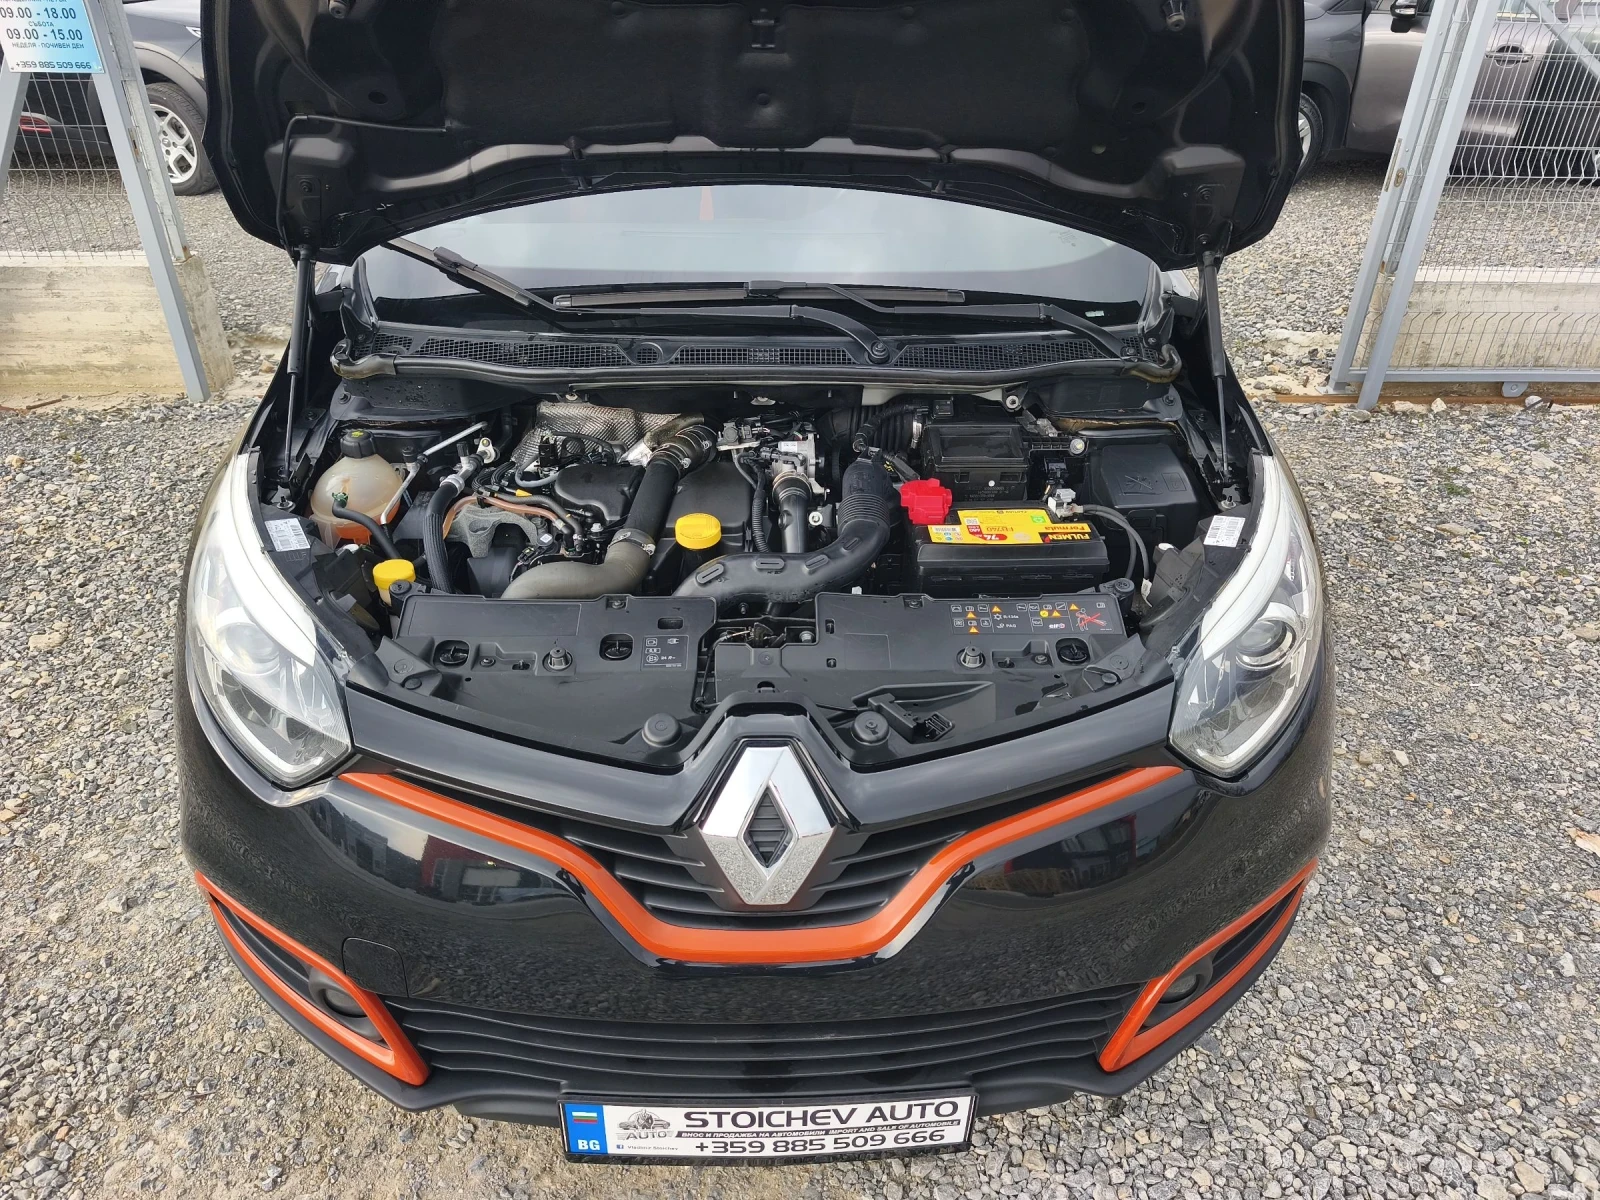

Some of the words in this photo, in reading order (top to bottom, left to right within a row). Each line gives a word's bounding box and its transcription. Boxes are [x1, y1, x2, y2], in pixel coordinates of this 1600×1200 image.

[0, 7, 32, 19] 09.00
[44, 7, 77, 20] 18.00
[6, 28, 39, 40] 09.00
[50, 28, 83, 41] 15.00
[16, 60, 37, 69] +359
[39, 60, 56, 69] 885
[56, 61, 74, 69] 509
[75, 61, 92, 69] 666
[683, 1107, 859, 1129] STOICHEV
[865, 1100, 959, 1123] AUTO
[909, 1120, 960, 1129] AUTOMOBILE
[626, 1130, 667, 1140] AUTO
[712, 1131, 758, 1139] ПРОДАЖБА
[771, 1129, 826, 1138] АВТОМОБИЛИ
[578, 1139, 600, 1151] BG
[695, 1140, 766, 1154] +359
[772, 1138, 827, 1153] 885
[833, 1134, 887, 1150] 509
[893, 1129, 946, 1145] 666
